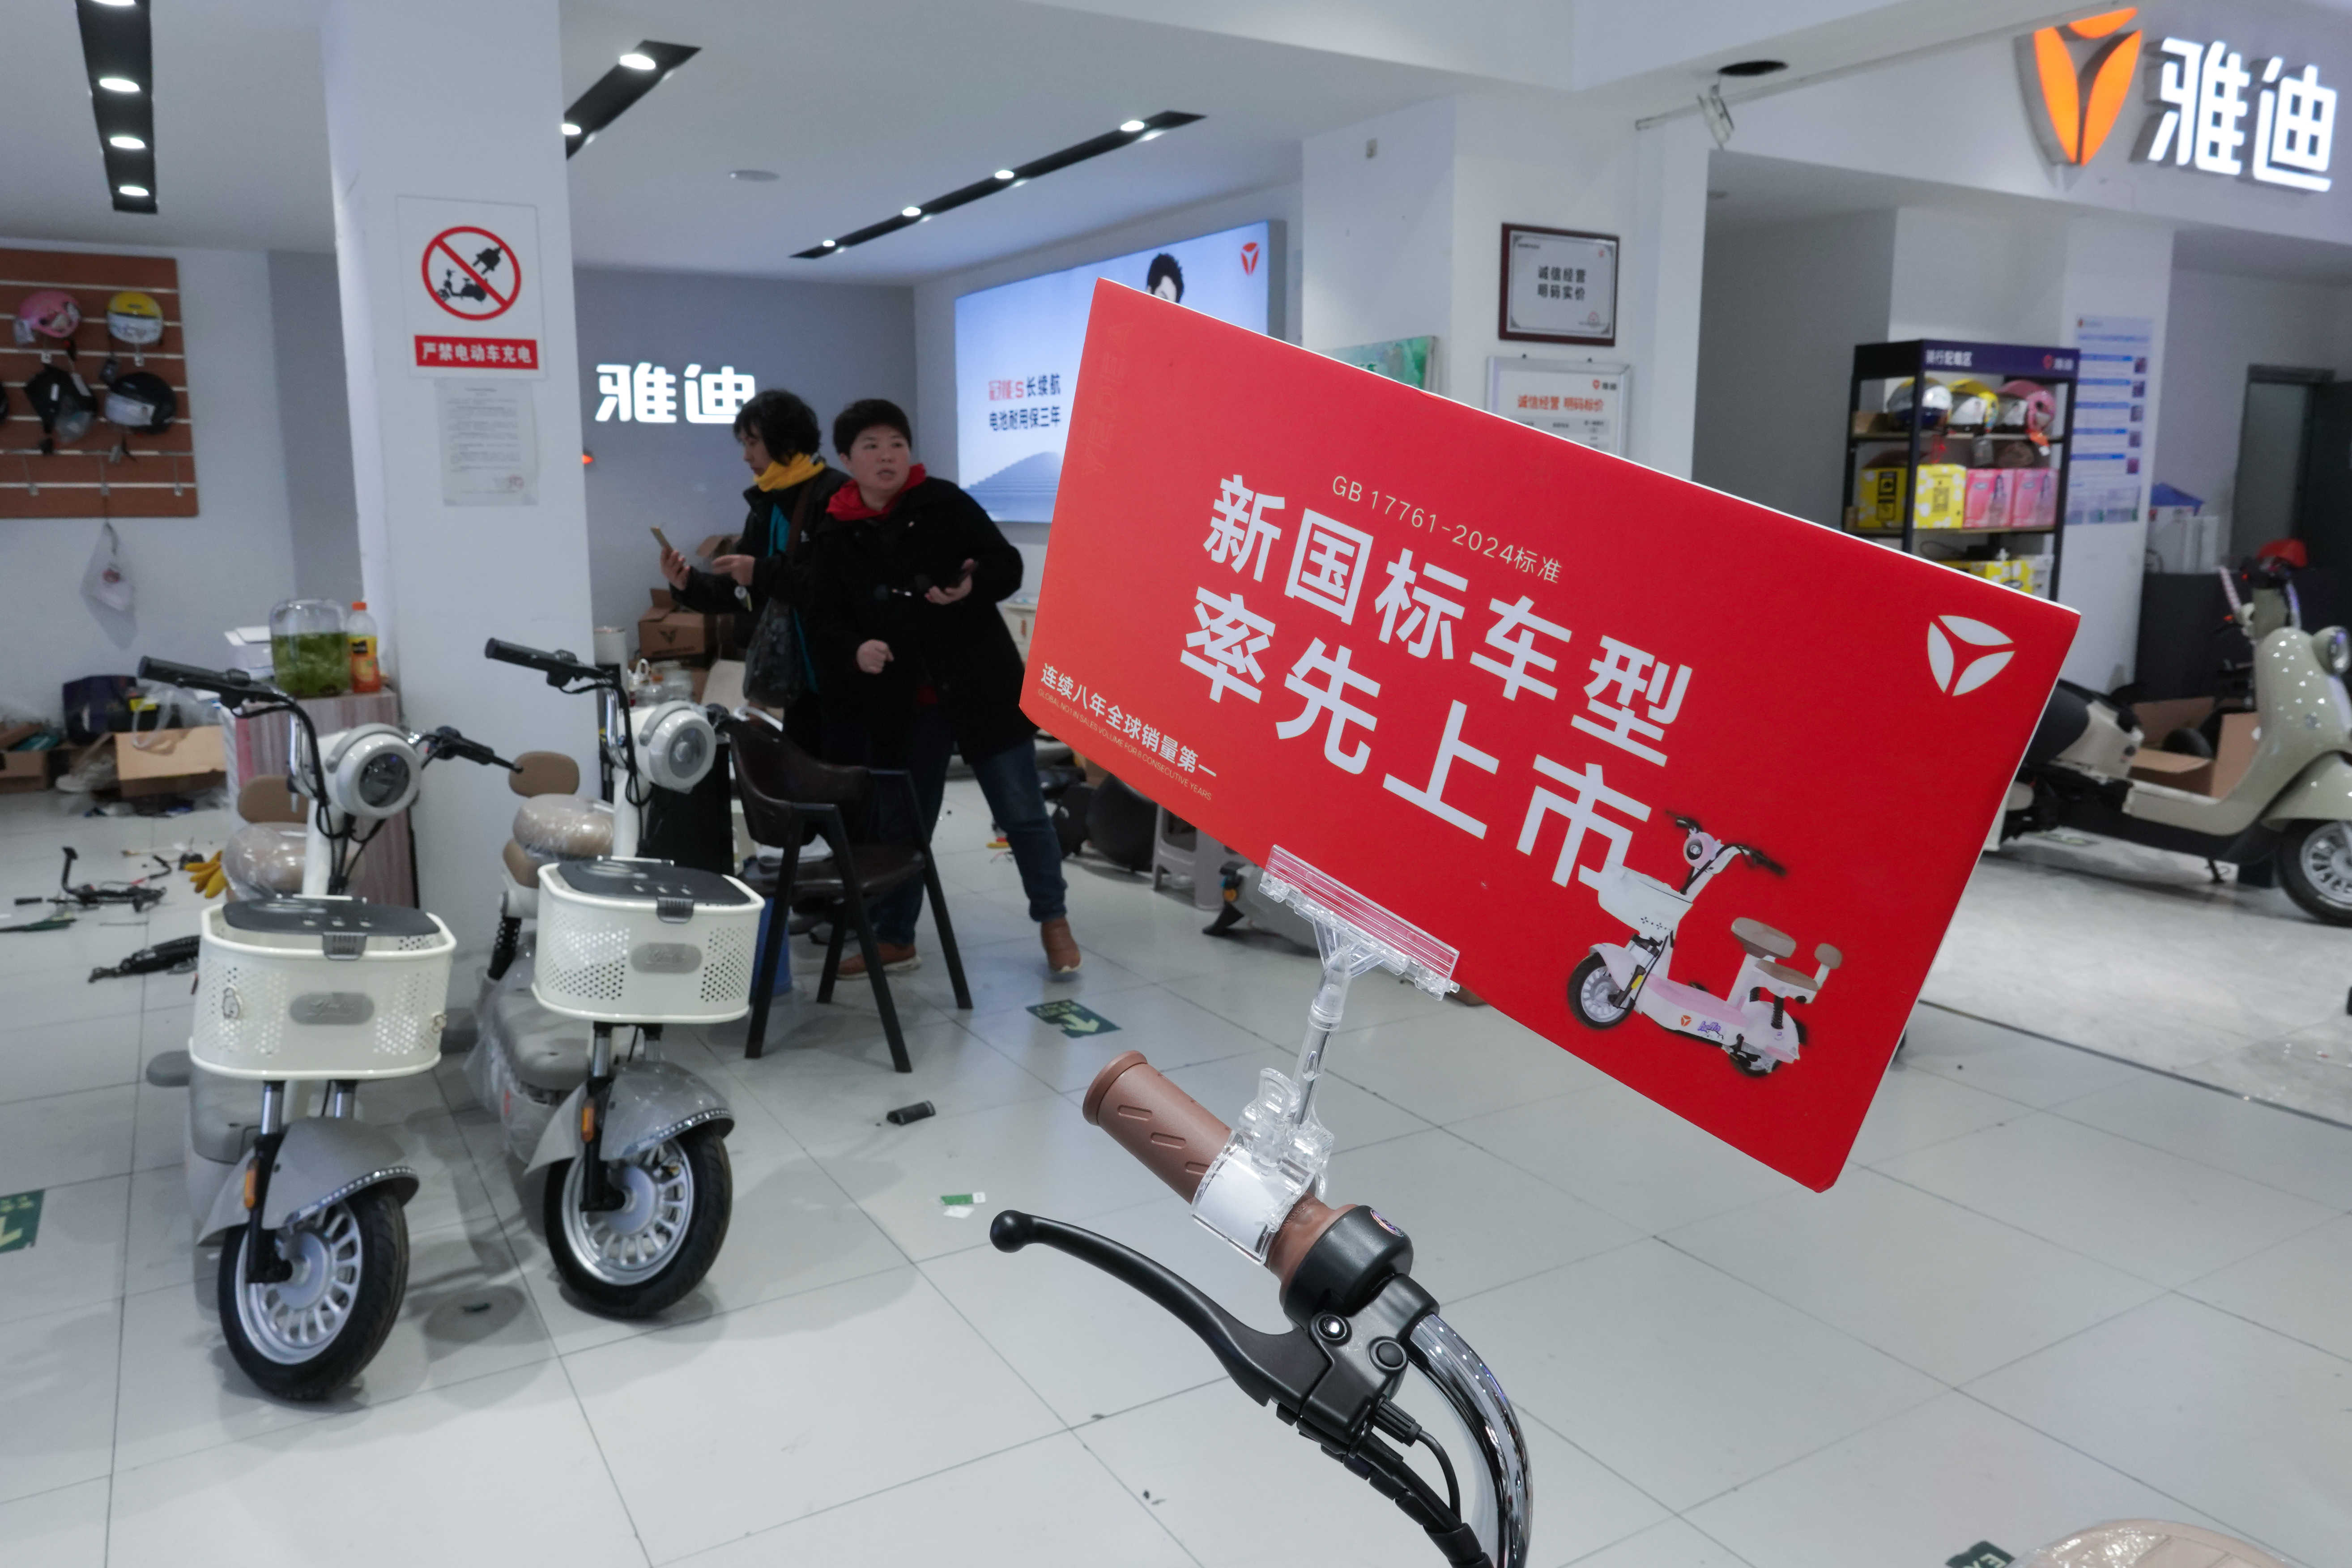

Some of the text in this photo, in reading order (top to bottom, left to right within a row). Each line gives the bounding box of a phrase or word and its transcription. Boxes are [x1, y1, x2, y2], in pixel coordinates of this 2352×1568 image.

[2148, 37, 2337, 192] 雅迪
[422, 341, 532, 363] 严禁电动车充电
[595, 362, 756, 424] 雅迪
[989, 405, 1061, 431] 电池耐用保三年
[1332, 476, 1562, 584] GB 17761-2024标准
[1203, 474, 1693, 767] 新国标车型
[1038, 688, 1059, 708] GLOBAL
[1073, 711, 1080, 720] IN
[1079, 714, 1099, 731] SALES
[1099, 726, 1125, 747] VOLUME
[1124, 742, 1138, 756] FOR
[1142, 754, 1189, 788] CONSECUTIVE
[1189, 783, 1212, 801] YEARS
[1040, 663, 1217, 777] 连续八年全球销量第一
[1180, 586, 1651, 891] 率先上市
